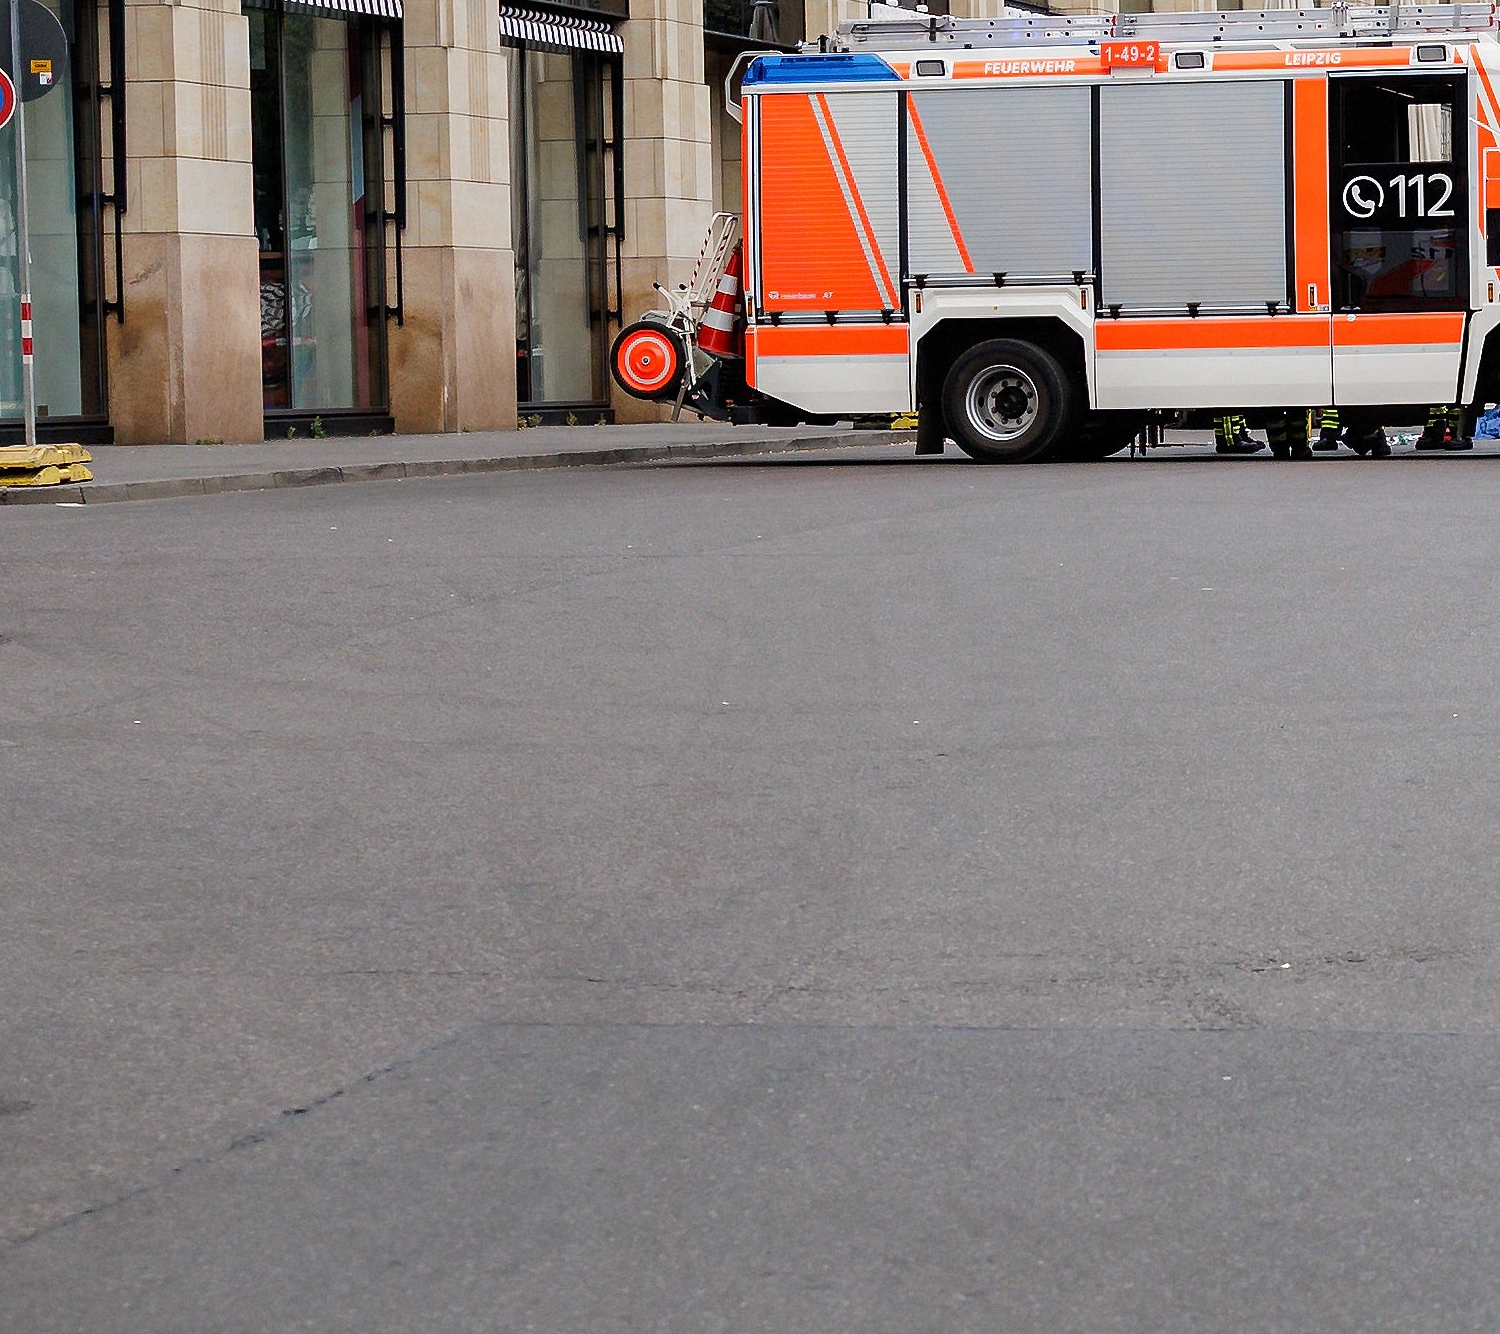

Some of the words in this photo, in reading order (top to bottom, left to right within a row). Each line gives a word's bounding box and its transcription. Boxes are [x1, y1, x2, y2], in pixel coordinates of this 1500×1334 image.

[1104, 45, 1156, 63] 1-49-2
[1284, 51, 1342, 67] LEIPZIG
[984, 60, 1076, 75] FEUERWEHR
[1389, 173, 1456, 218] 112
